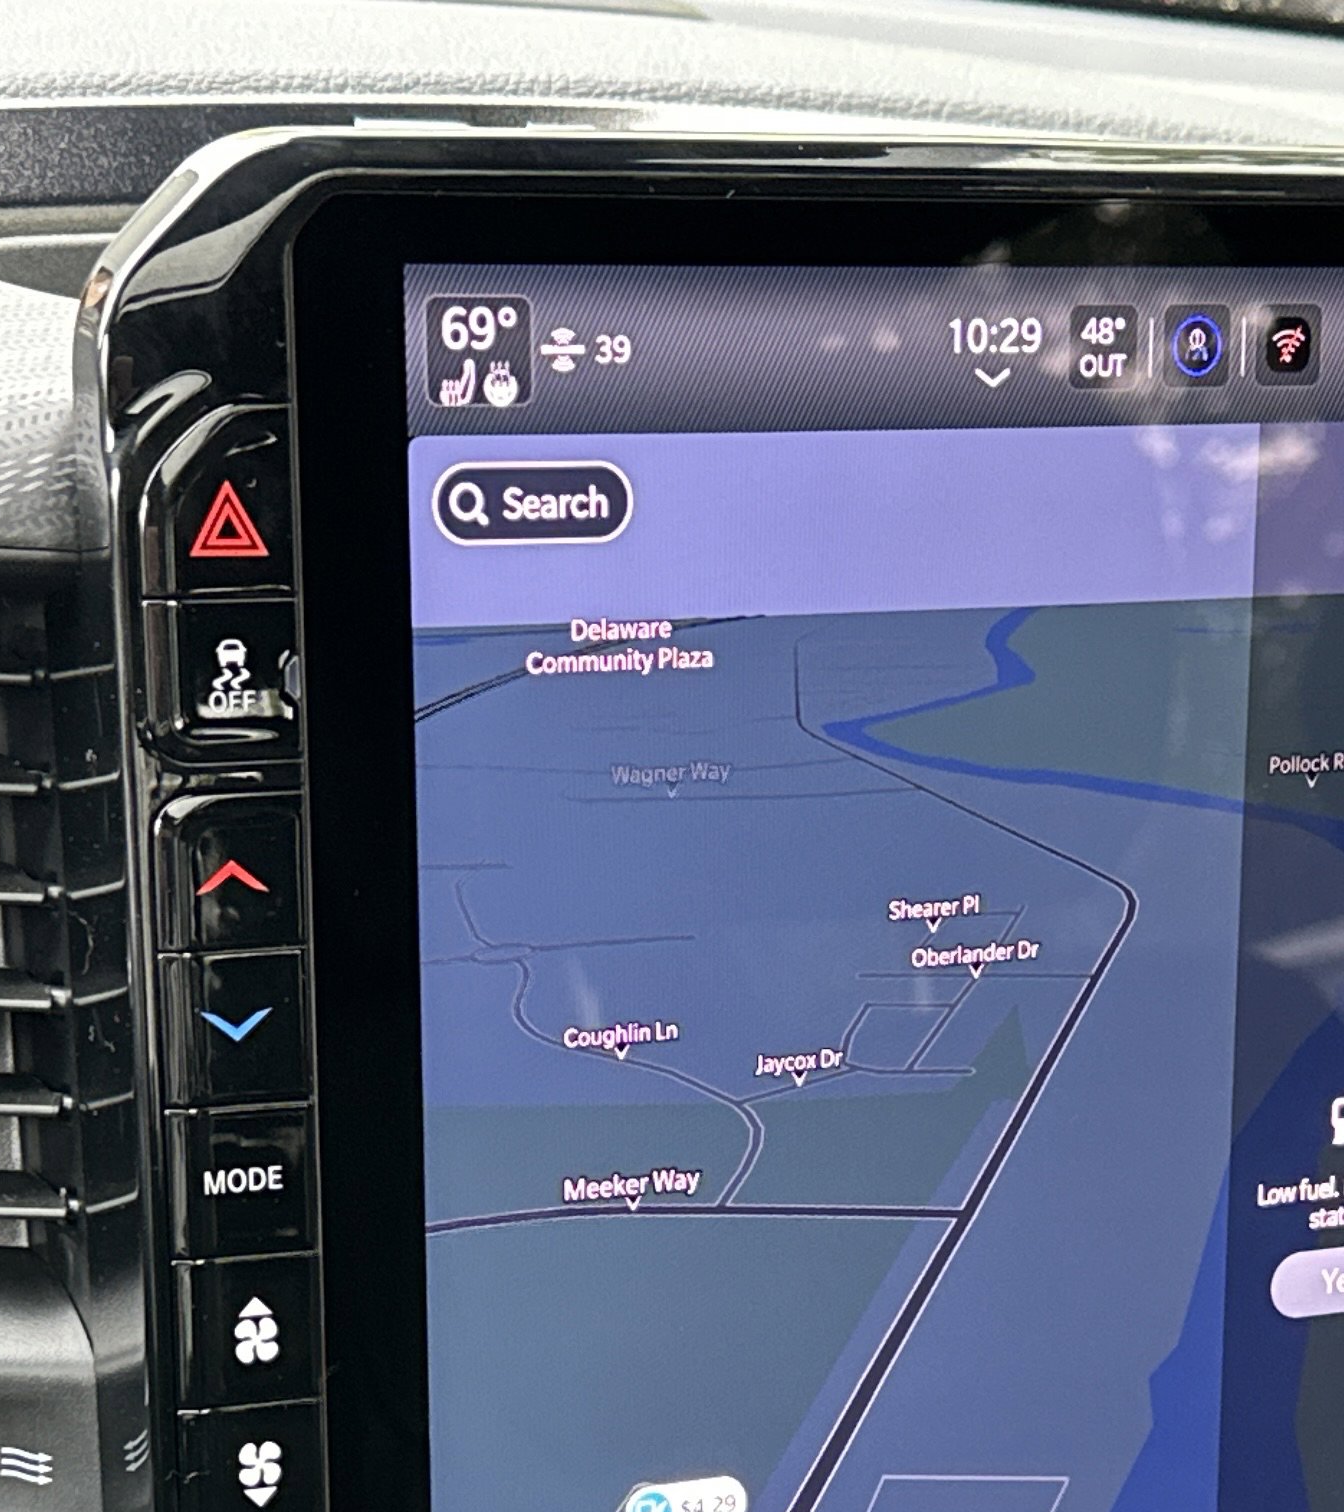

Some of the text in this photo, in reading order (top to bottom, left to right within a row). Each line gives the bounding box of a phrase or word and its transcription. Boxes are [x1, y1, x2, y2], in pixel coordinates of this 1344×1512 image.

[441, 306, 517, 351] 69°
[950, 317, 1042, 353] 10:29
[1080, 316, 1126, 344] 48°
[595, 335, 631, 363] 39
[1080, 354, 1126, 377] OUT
[503, 485, 608, 519] Search
[570, 618, 672, 640] Delaware
[526, 647, 713, 675] Community Plaza
[208, 691, 254, 713] OFF
[611, 762, 730, 786] Wagner Way
[1269, 754, 1329, 774] Pollock
[889, 898, 958, 920] Shearer
[912, 941, 1039, 968] Oberlander Dr
[564, 1022, 678, 1050] Coughlin Ln
[755, 1049, 842, 1077] Jaycox Dr
[204, 1165, 283, 1195] MODE
[564, 1170, 700, 1200] Meeker Way
[1257, 1183, 1297, 1207] Low
[1299, 1176, 1338, 1201] fuel.
